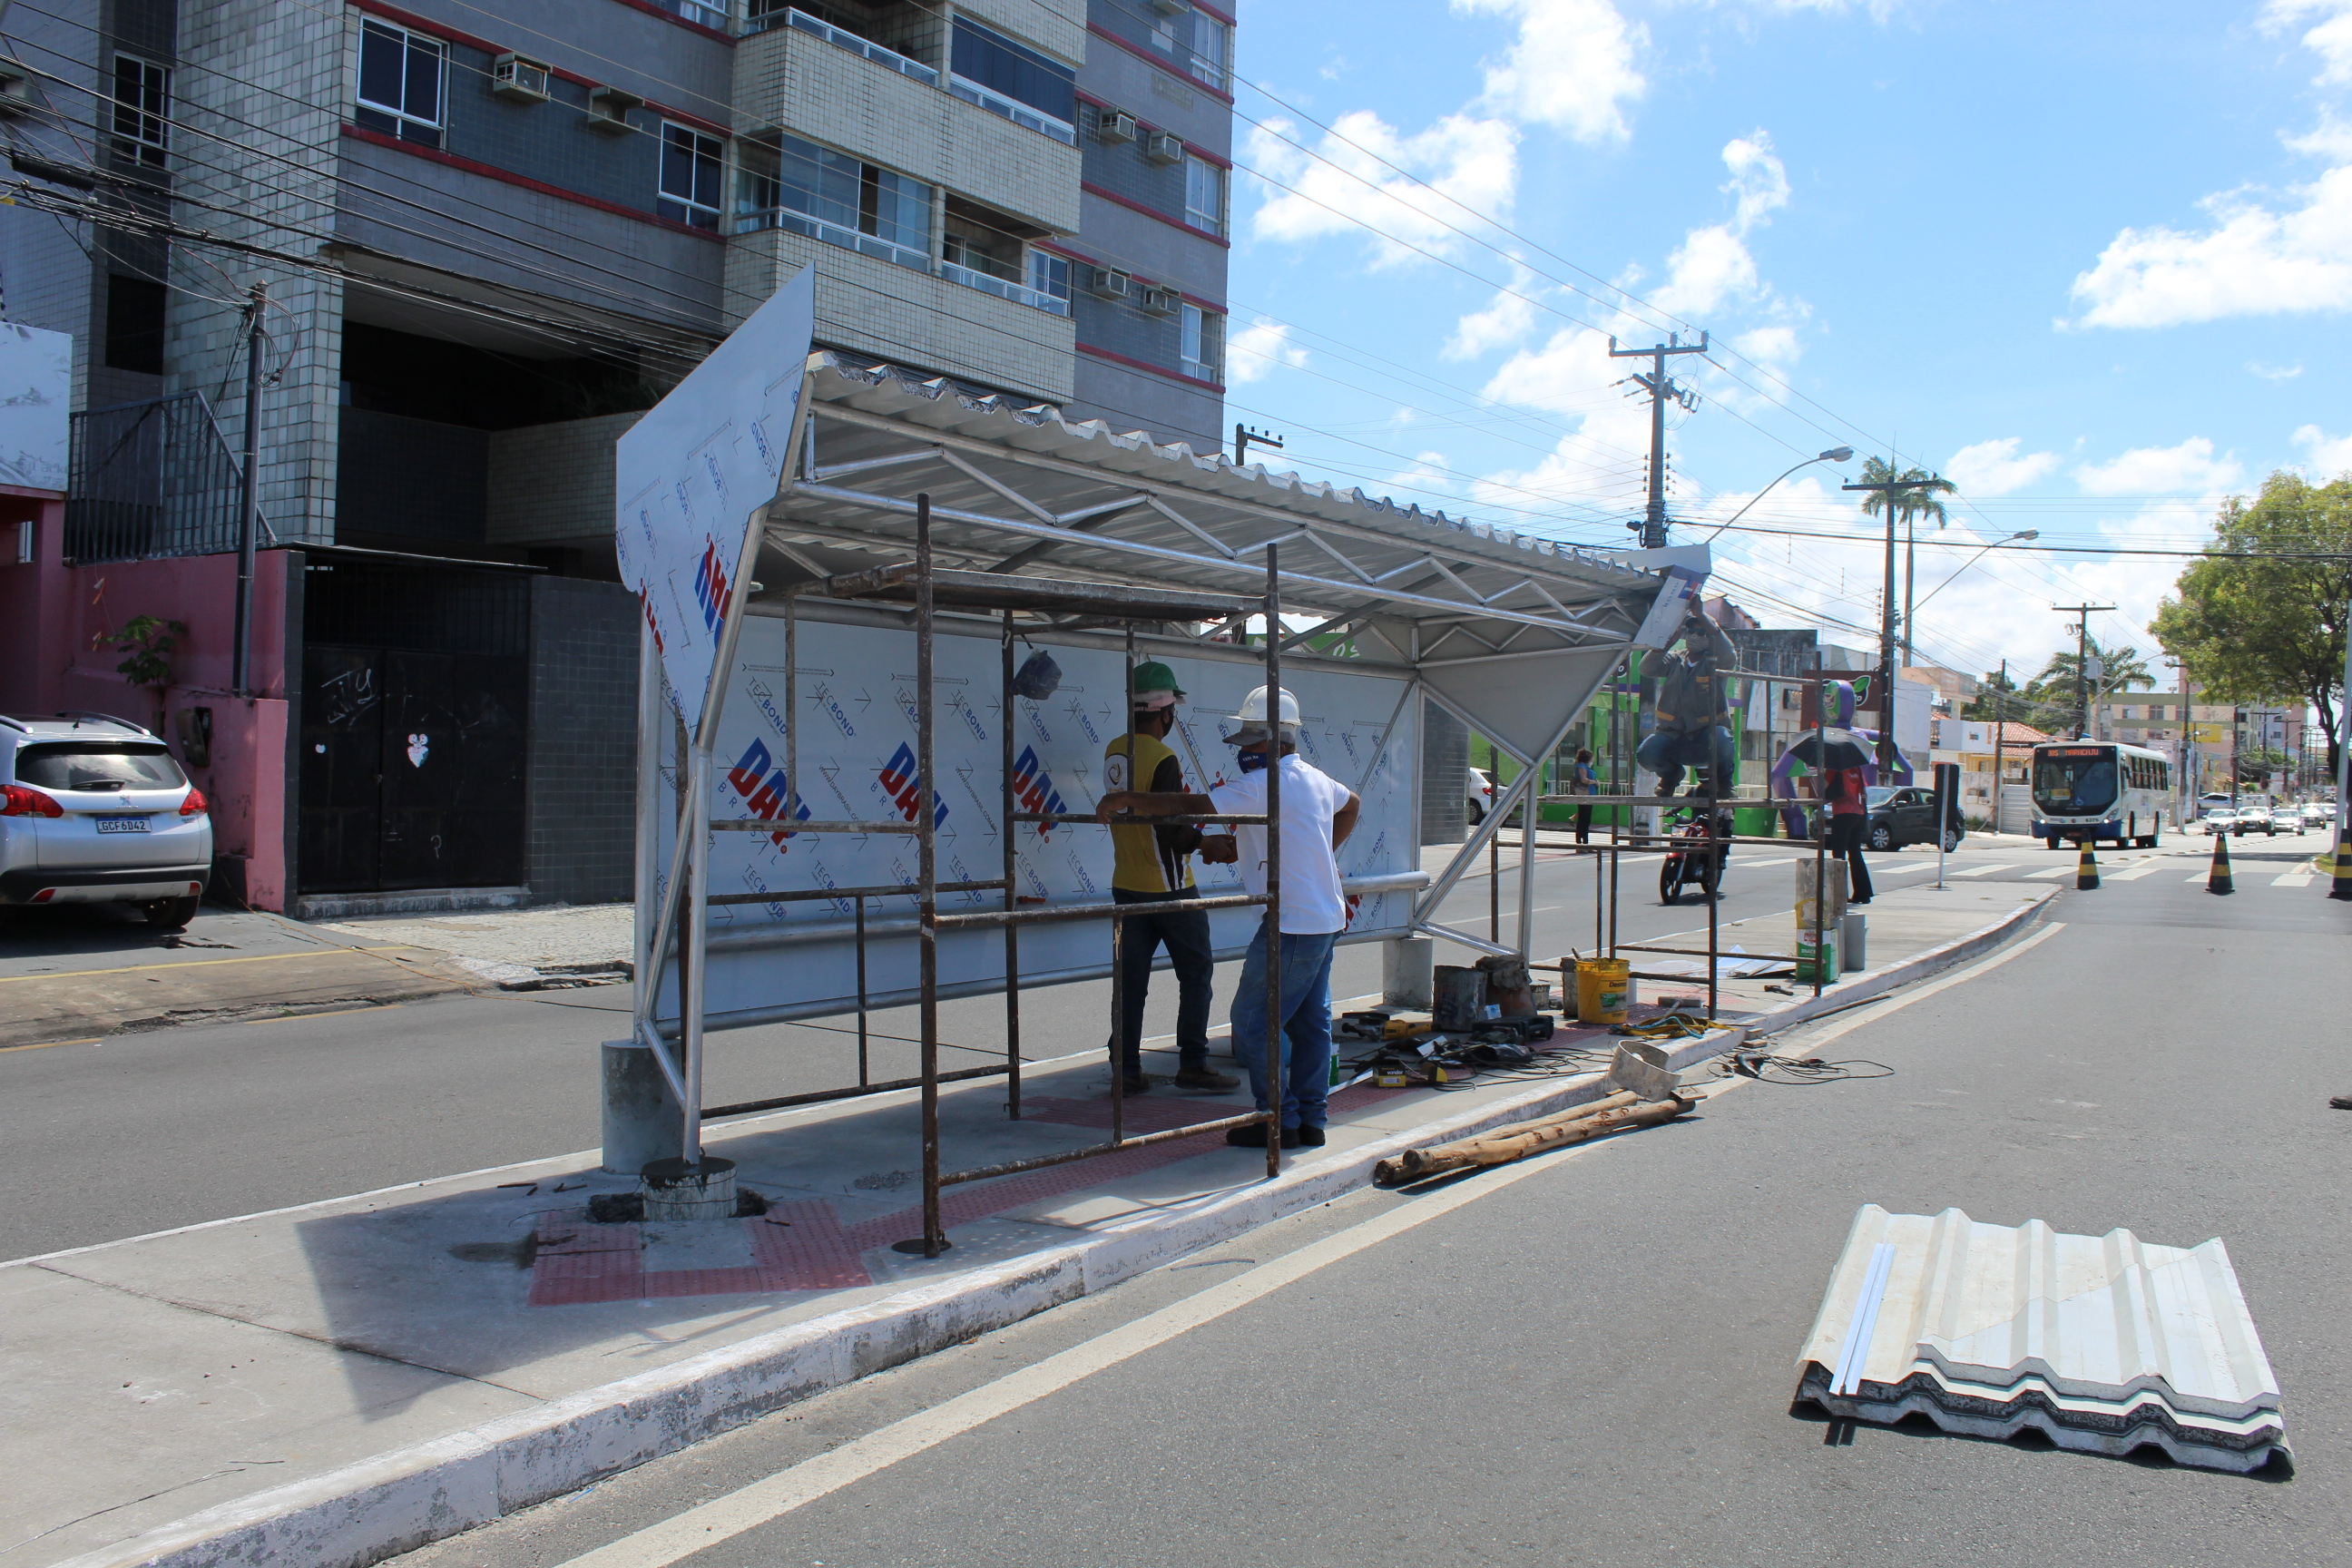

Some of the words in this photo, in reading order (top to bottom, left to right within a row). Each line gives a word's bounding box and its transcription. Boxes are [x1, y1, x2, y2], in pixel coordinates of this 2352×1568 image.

[749, 677, 787, 735] TECBOND
[818, 681, 855, 737] TECBOND
[896, 685, 919, 723] TECBO
[955, 690, 985, 740] TECBOND
[1072, 696, 1099, 744] TECBOND
[102, 821, 146, 831] GCF6D42
[744, 863, 784, 918] TECBND
[814, 860, 851, 913] TECBND
[1018, 851, 1046, 898] TECBOND
[1068, 848, 1095, 894] TECBOND
